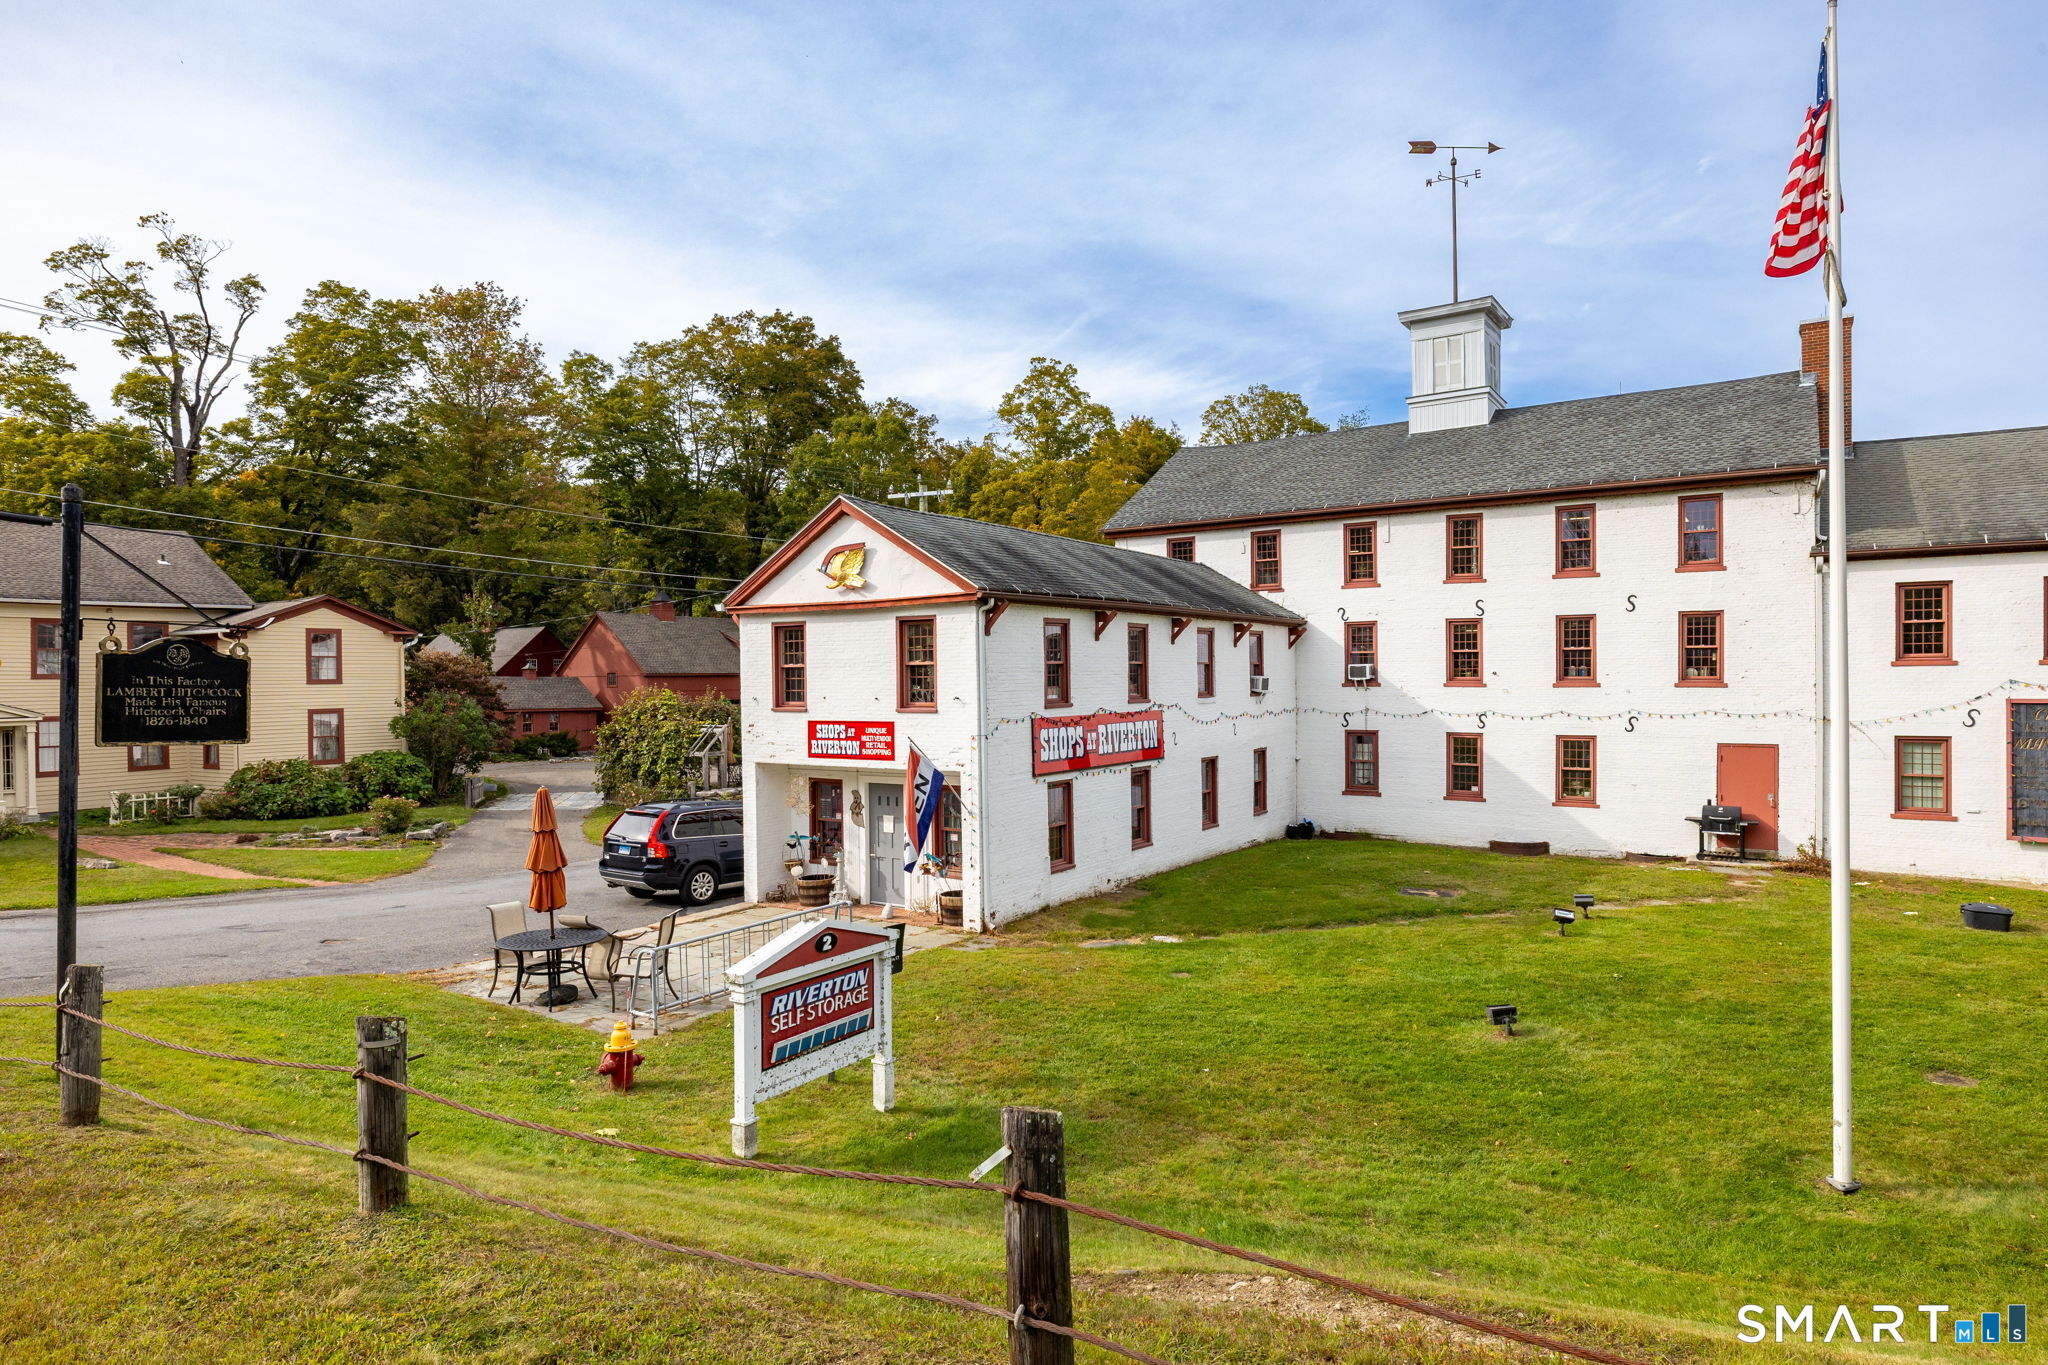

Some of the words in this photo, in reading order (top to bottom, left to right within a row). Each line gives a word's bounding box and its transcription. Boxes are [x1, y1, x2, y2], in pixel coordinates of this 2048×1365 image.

[147, 676, 173, 685] This
[106, 687, 167, 697] LAMBERT
[171, 688, 242, 697] HITCHCOCK
[125, 698, 157, 706] Made
[162, 698, 181, 707] His
[186, 698, 227, 706] Famous
[125, 707, 185, 716] Hitchcock
[190, 707, 227, 716] Chairs
[145, 717, 208, 726] 1826-1840
[816, 724, 846, 739] SHOPS
[847, 728, 856, 737] AT
[1040, 726, 1084, 762] SHOPS
[1086, 732, 1097, 751] AT
[1097, 719, 1158, 755] RIVERTON
[811, 740, 860, 755] RIVERTON
[862, 748, 892, 756] SHOPPING
[822, 935, 832, 951] 2
[769, 968, 870, 1017] RIVERTON
[771, 1008, 805, 1034] SELF
[806, 985, 869, 1021] STORAGE
